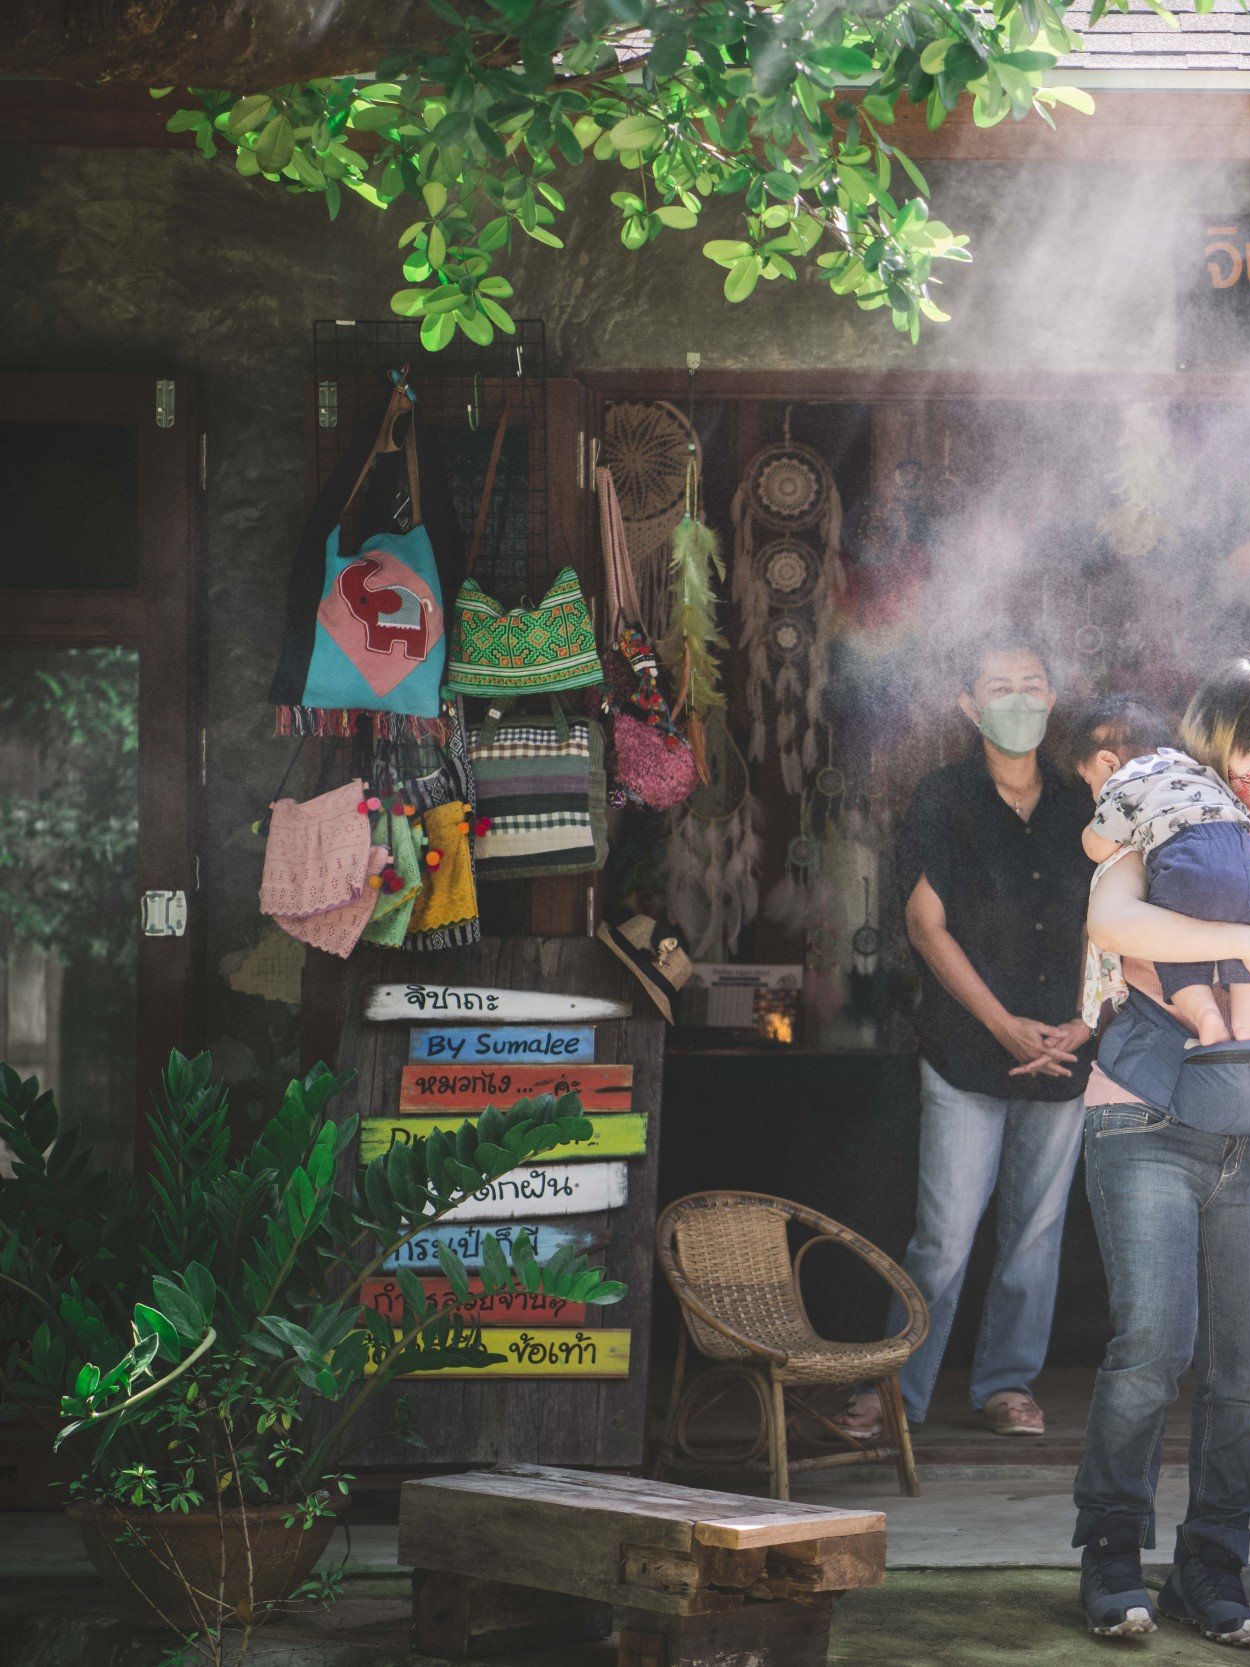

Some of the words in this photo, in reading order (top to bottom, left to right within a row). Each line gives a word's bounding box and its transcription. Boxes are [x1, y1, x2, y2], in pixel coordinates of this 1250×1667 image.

[404, 985, 499, 1011] จิปาถะ
[474, 1033, 581, 1055] Sumalee
[509, 1332, 597, 1365] ข้อเท้า
